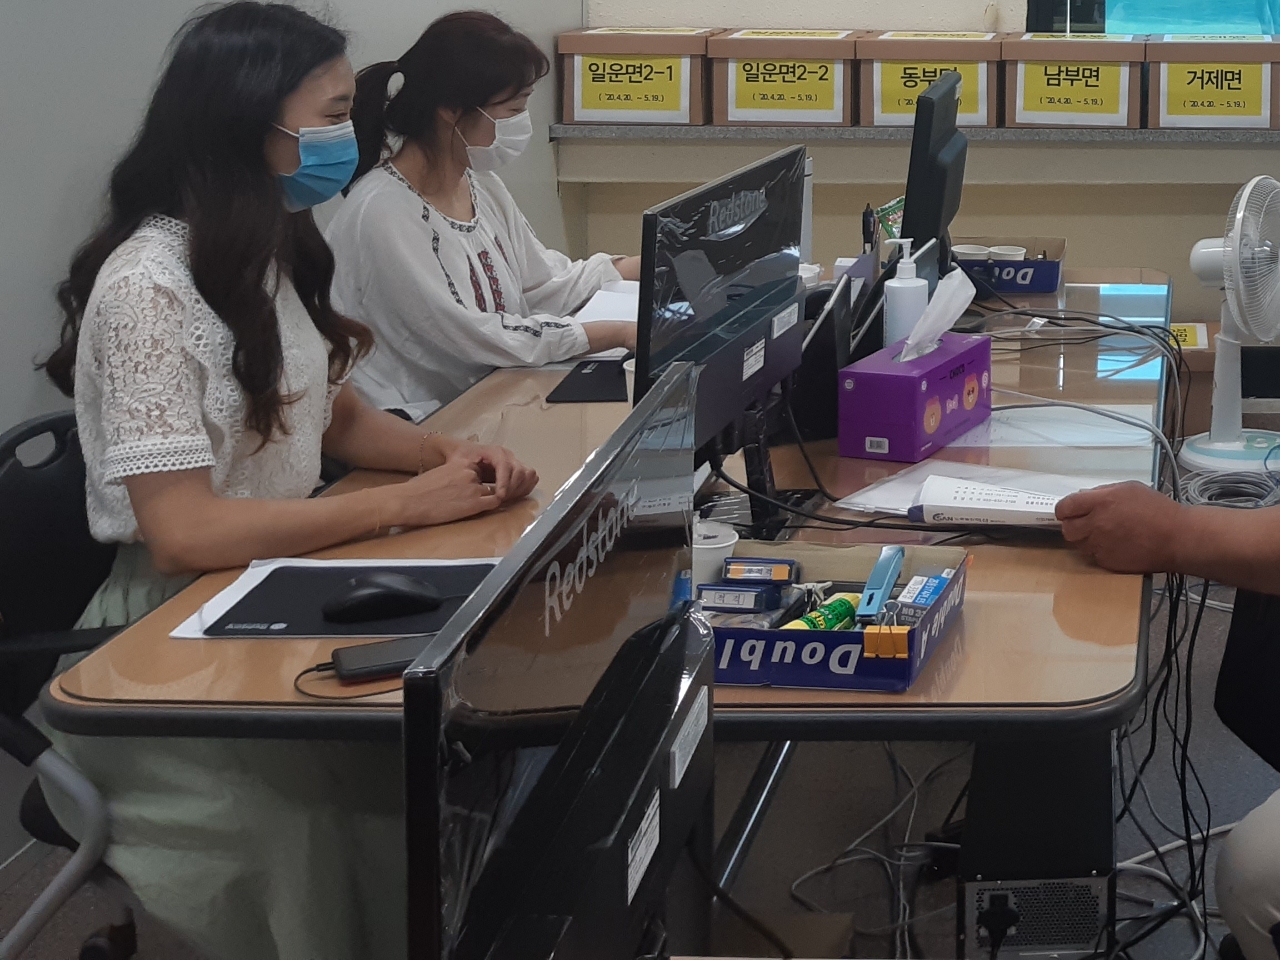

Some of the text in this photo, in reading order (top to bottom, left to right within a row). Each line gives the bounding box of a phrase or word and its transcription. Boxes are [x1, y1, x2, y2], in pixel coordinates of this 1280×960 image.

[588, 62, 673, 83] 일운면2-1
[742, 62, 829, 83] 일운면2-2
[900, 66, 958, 88] 동부
[1044, 65, 1100, 87] 남부면
[1186, 69, 1242, 90] 거제면
[718, 638, 862, 675] Doubl
